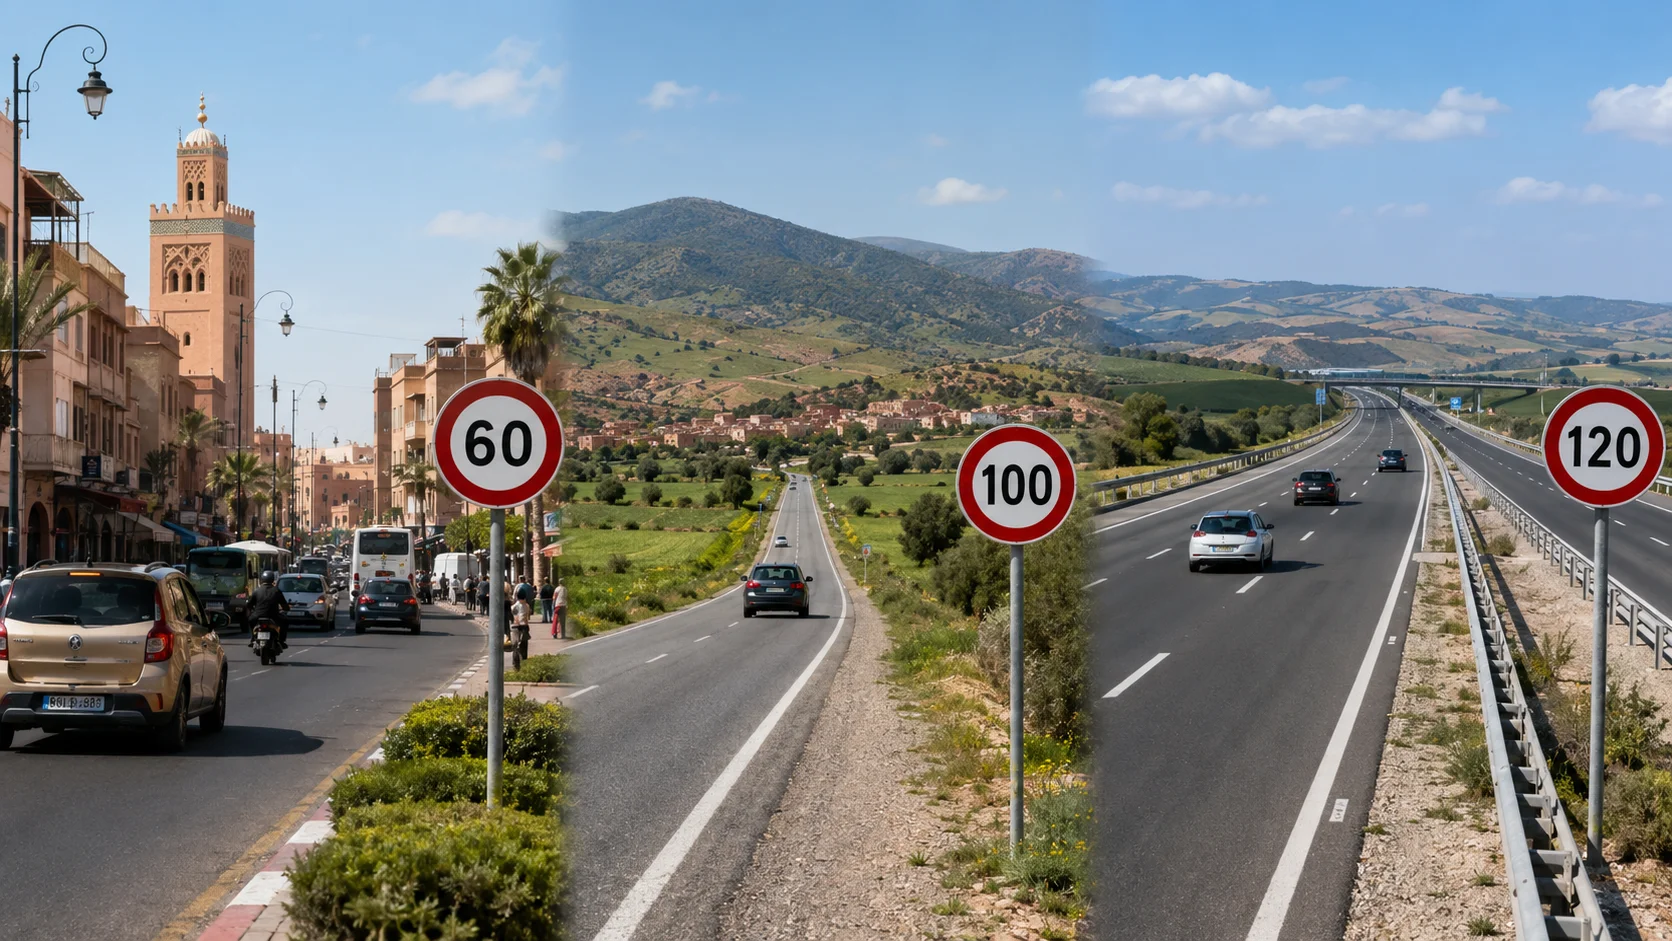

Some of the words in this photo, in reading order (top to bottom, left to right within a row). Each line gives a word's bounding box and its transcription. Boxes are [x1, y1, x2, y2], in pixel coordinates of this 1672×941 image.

[465, 419, 532, 467] 60
[1568, 425, 1641, 469] 120
[982, 464, 1053, 506] 100
